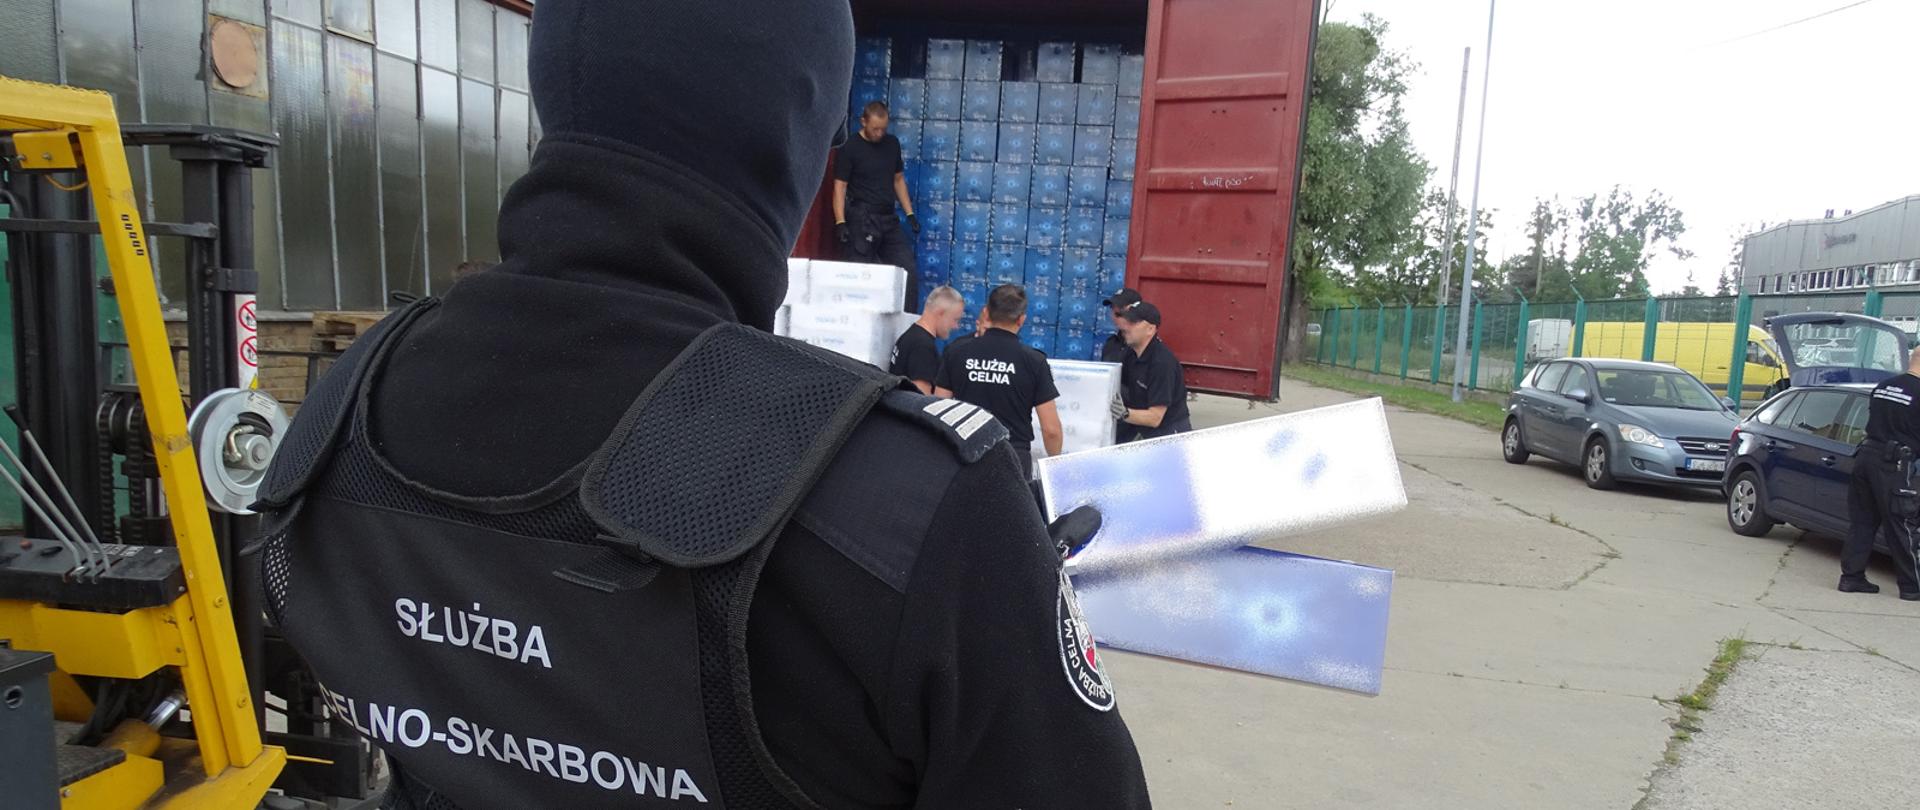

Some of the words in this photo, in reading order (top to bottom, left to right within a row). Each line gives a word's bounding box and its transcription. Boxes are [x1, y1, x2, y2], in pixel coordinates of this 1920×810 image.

[965, 358, 1016, 374] SŁUŻBA
[968, 370, 1010, 385] CELNA
[395, 597, 552, 668] SŁUŻBA
[1063, 618, 1080, 668] CELNA
[318, 681, 708, 803] CELNO-SKARBOWA
